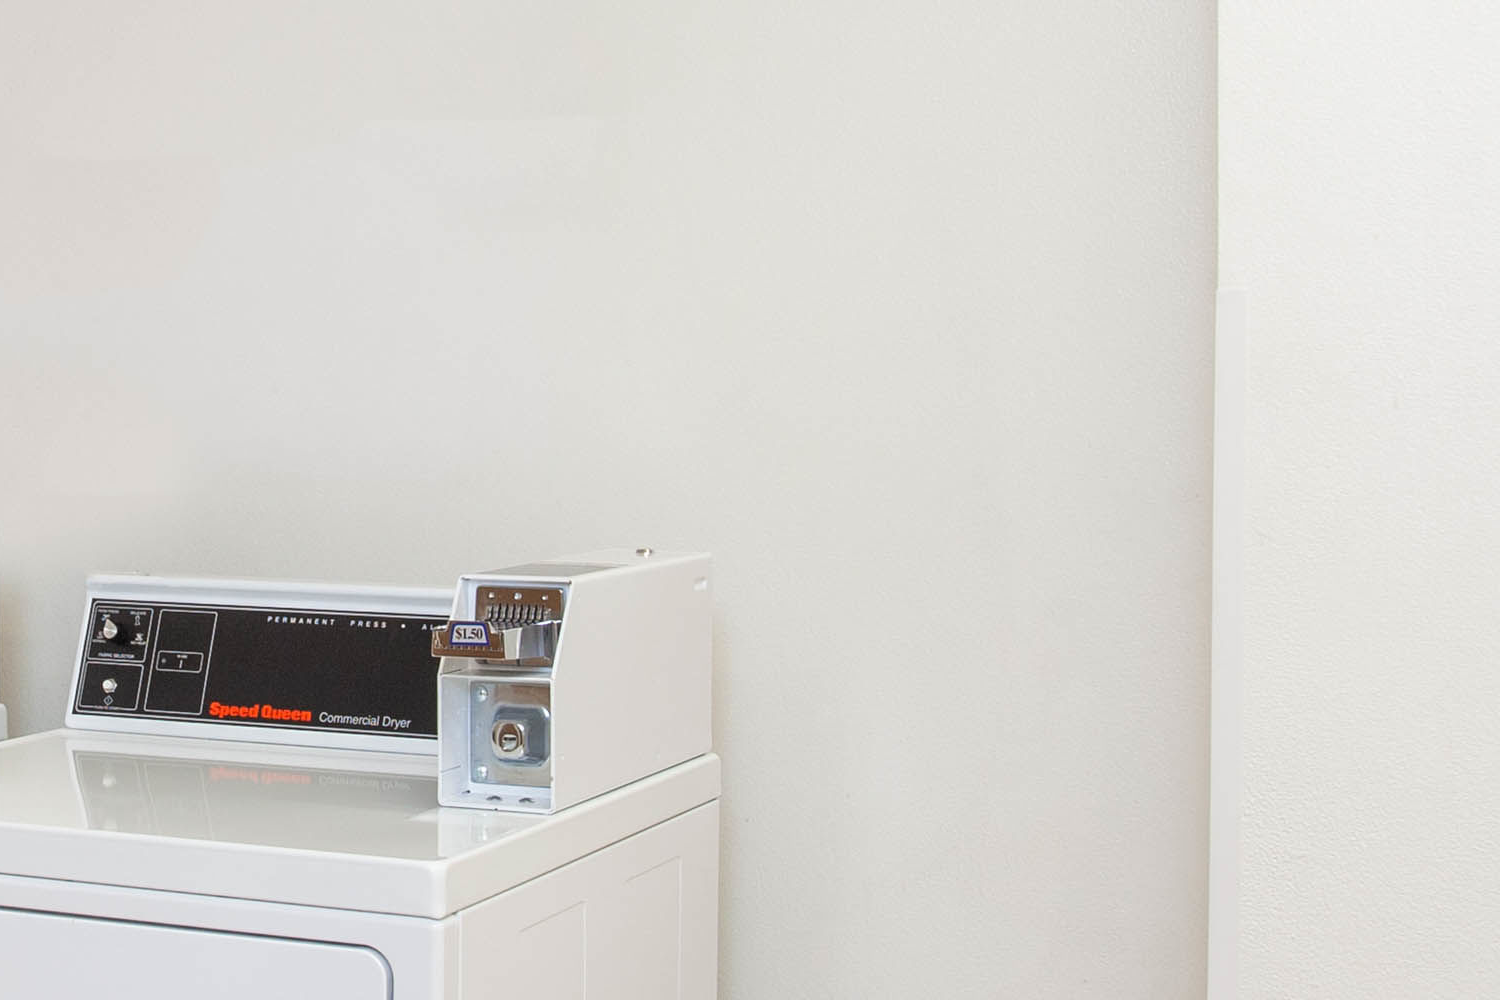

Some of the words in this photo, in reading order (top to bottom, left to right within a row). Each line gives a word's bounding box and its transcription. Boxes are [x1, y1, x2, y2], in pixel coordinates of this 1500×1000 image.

[267, 615, 335, 626] PERMANENT
[350, 620, 387, 629] PRESS
[455, 628, 483, 640] $1.50
[209, 701, 259, 720] Speed
[261, 704, 312, 722] Queen
[319, 711, 380, 726] Commercial
[382, 714, 411, 729] Dryer
